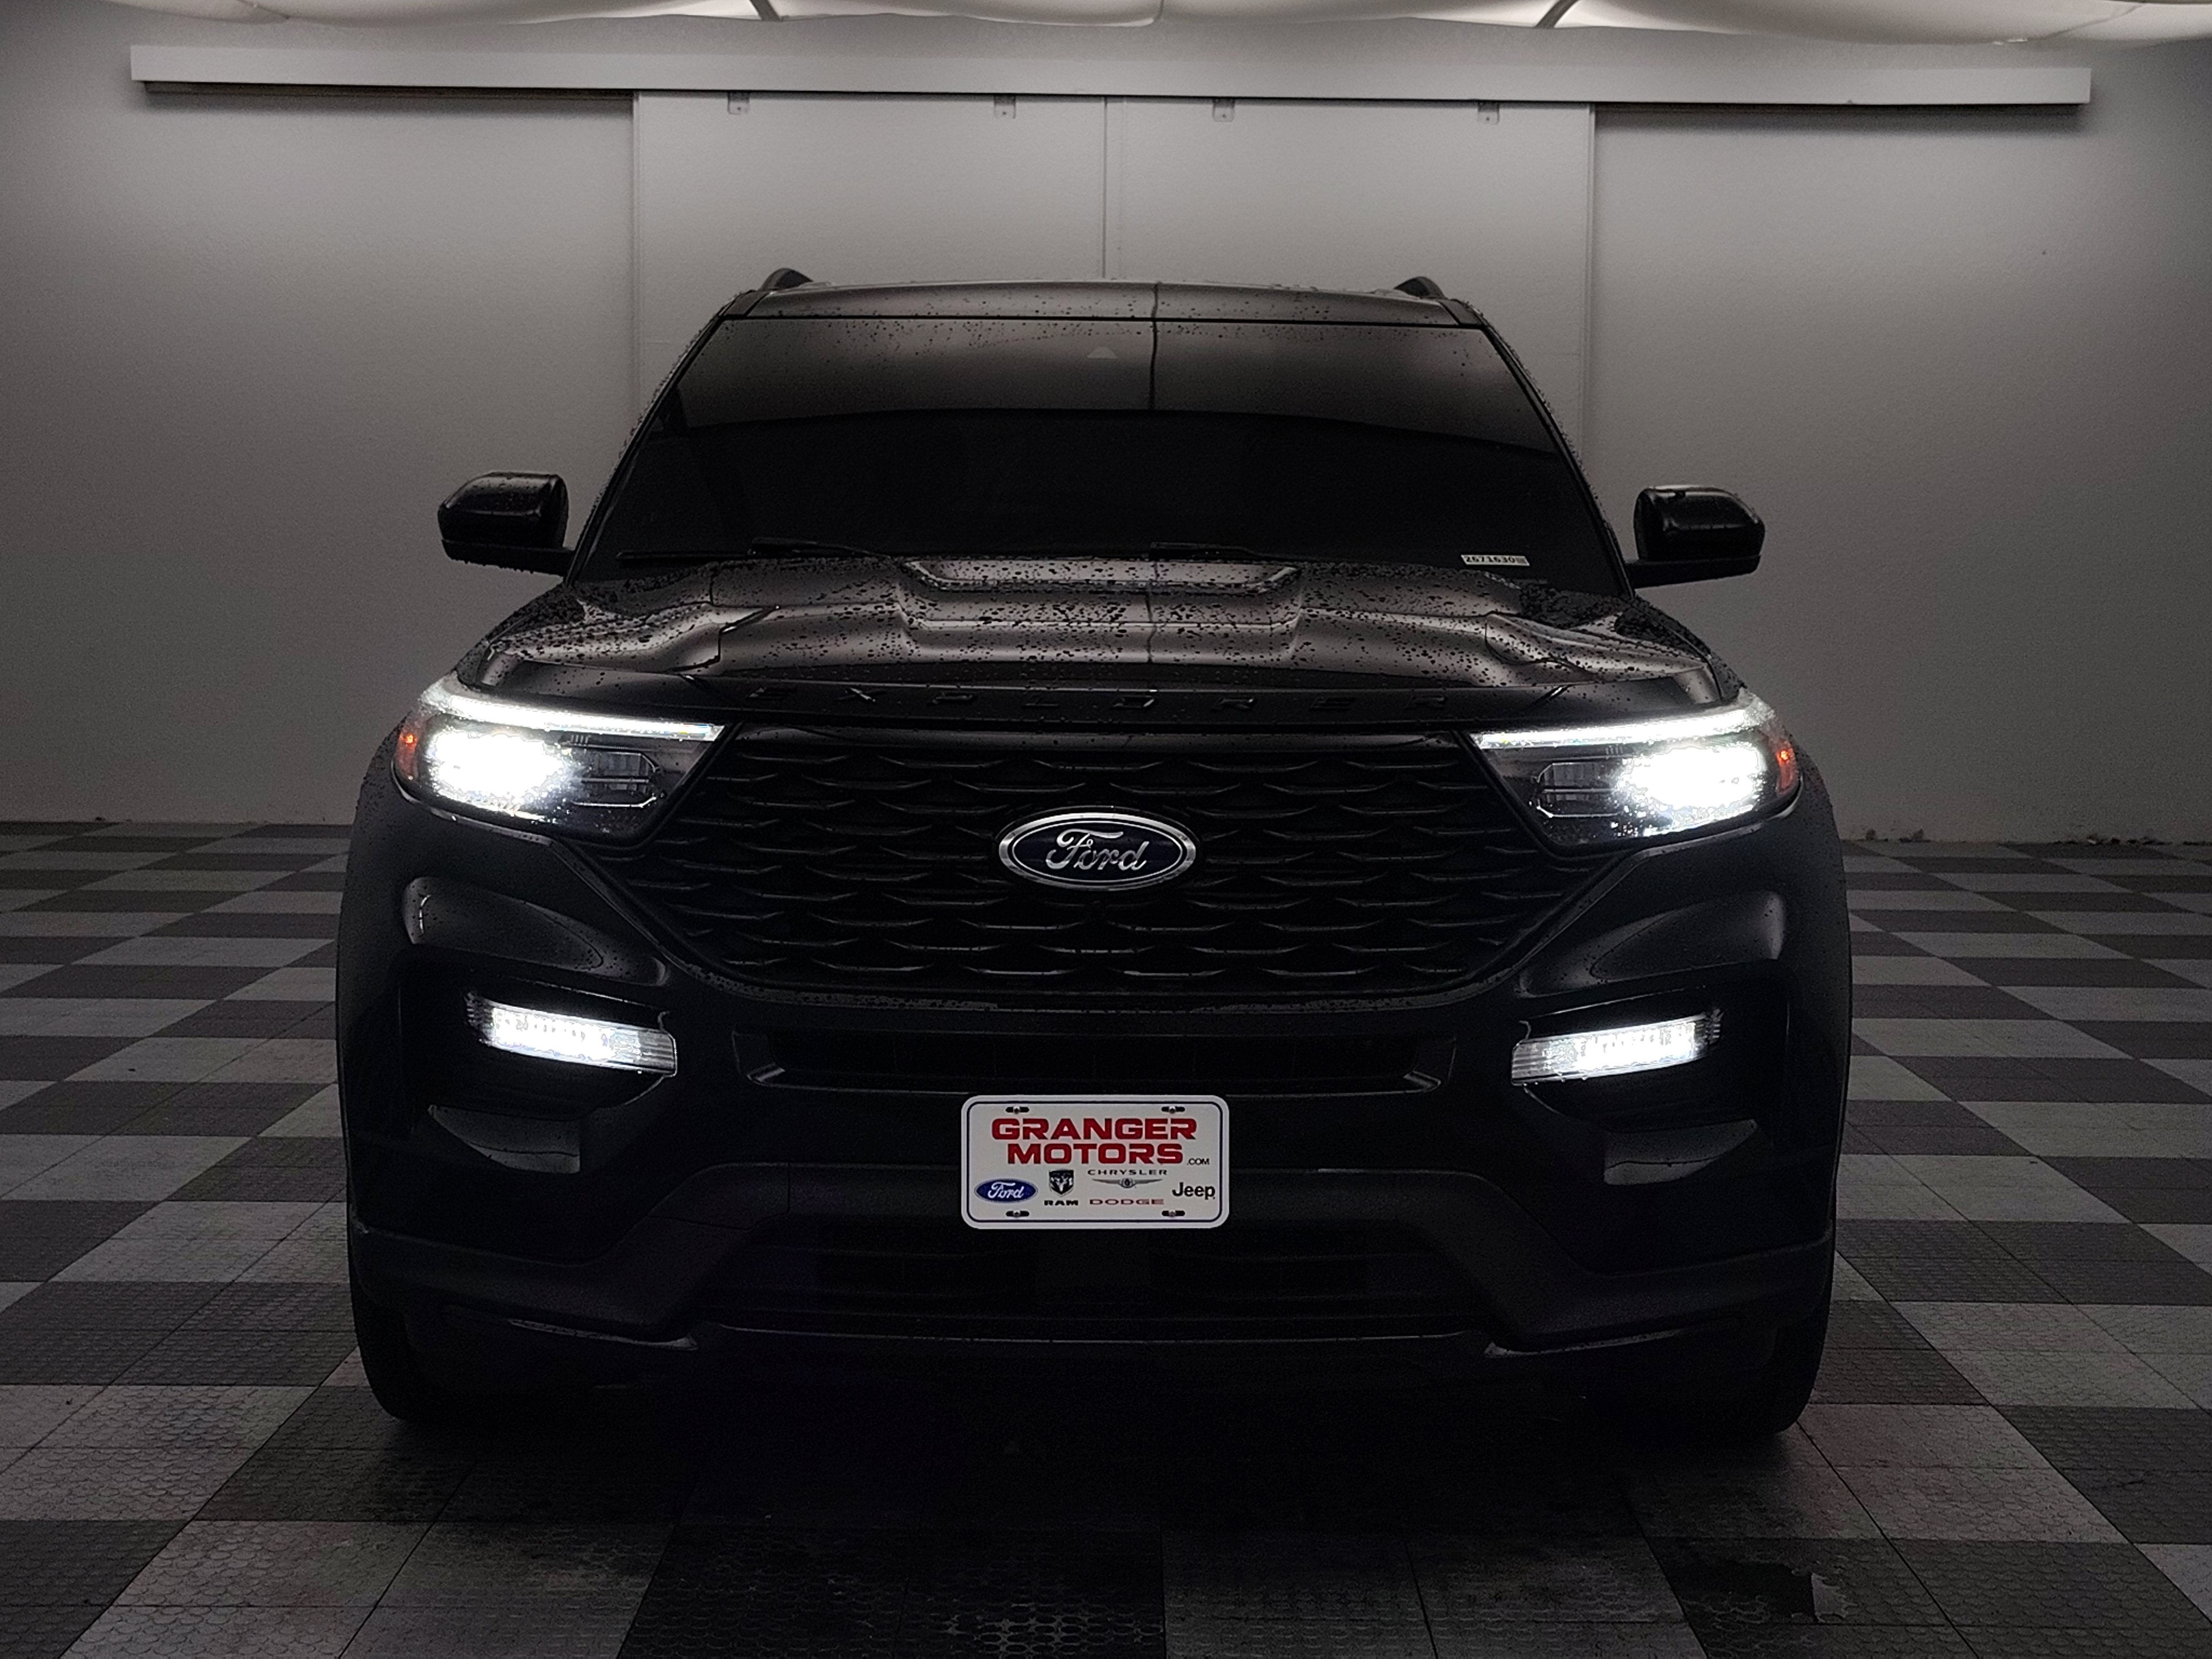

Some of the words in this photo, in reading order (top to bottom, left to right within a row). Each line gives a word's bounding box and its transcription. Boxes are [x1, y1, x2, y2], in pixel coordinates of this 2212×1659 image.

[744, 686, 1447, 711] EXPLORER
[1046, 818, 1150, 871] Ford
[992, 1117, 1197, 1141] GRANGER
[1007, 1143, 1183, 1164] MOTORS
[987, 1181, 1025, 1199] Ford
[1172, 1182, 1215, 1200] Jeep
